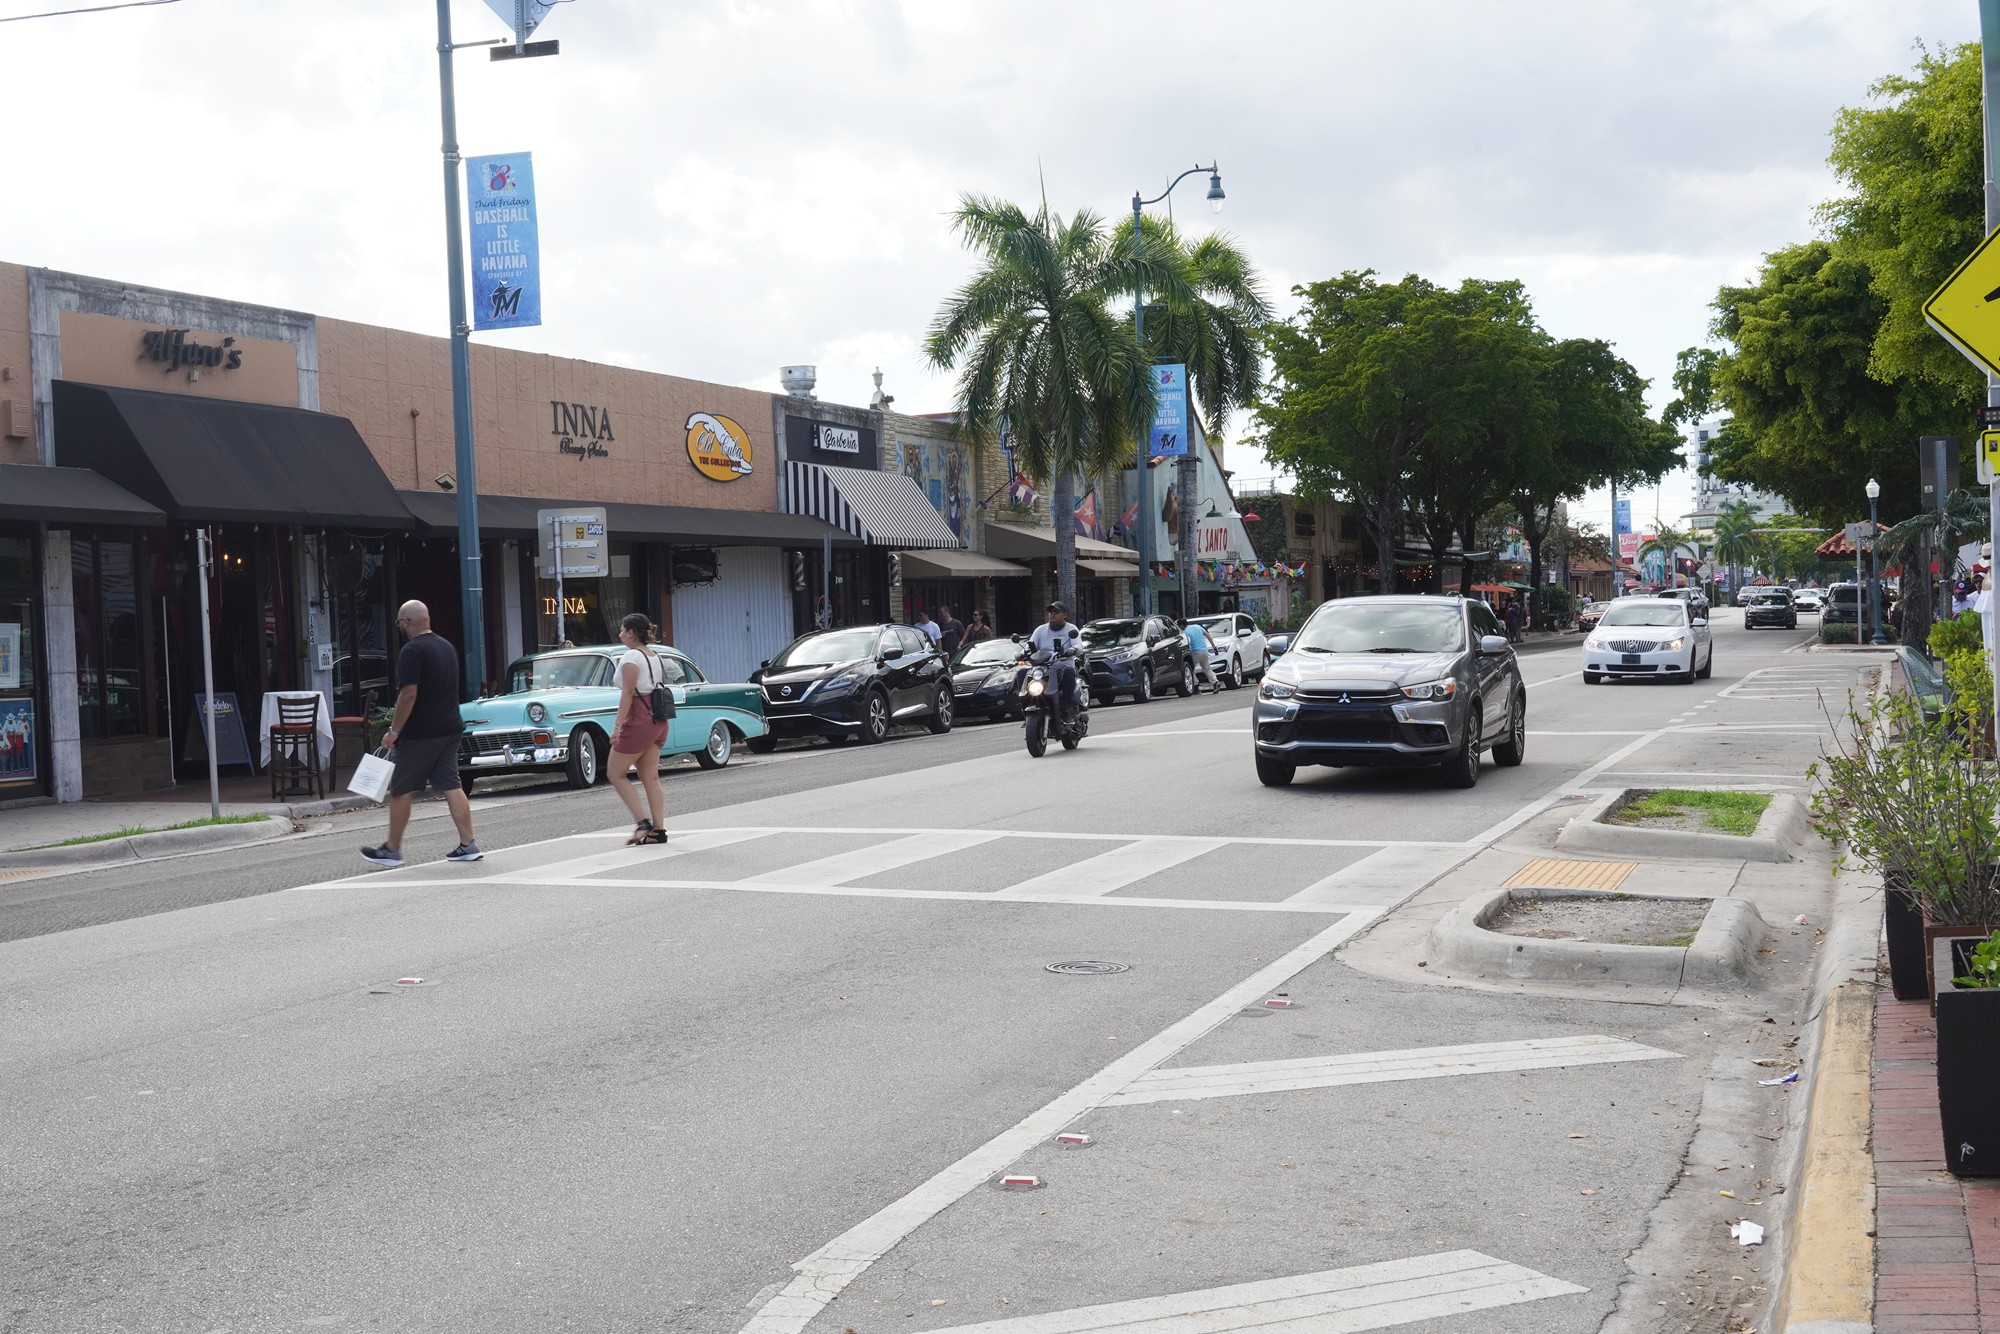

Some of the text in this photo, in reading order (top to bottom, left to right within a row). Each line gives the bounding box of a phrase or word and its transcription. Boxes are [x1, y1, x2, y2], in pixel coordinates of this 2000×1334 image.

[474, 197, 531, 208] Third Fridays
[475, 207, 530, 225] BASEBALL
[496, 224, 508, 239] IS
[487, 239, 520, 255] LITTLE
[481, 254, 528, 271] HAVANA
[1158, 409, 1177, 417] LITTLE
[1163, 401, 1171, 409] IS
[551, 401, 615, 441] INNA
[1155, 416, 1181, 426] HAVANA
[560, 437, 609, 462] Beauty Salon
[696, 432, 743, 459] Old Cuba
[699, 456, 742, 468] THE COLLECTION
[1205, 527, 1228, 552] SANTO
